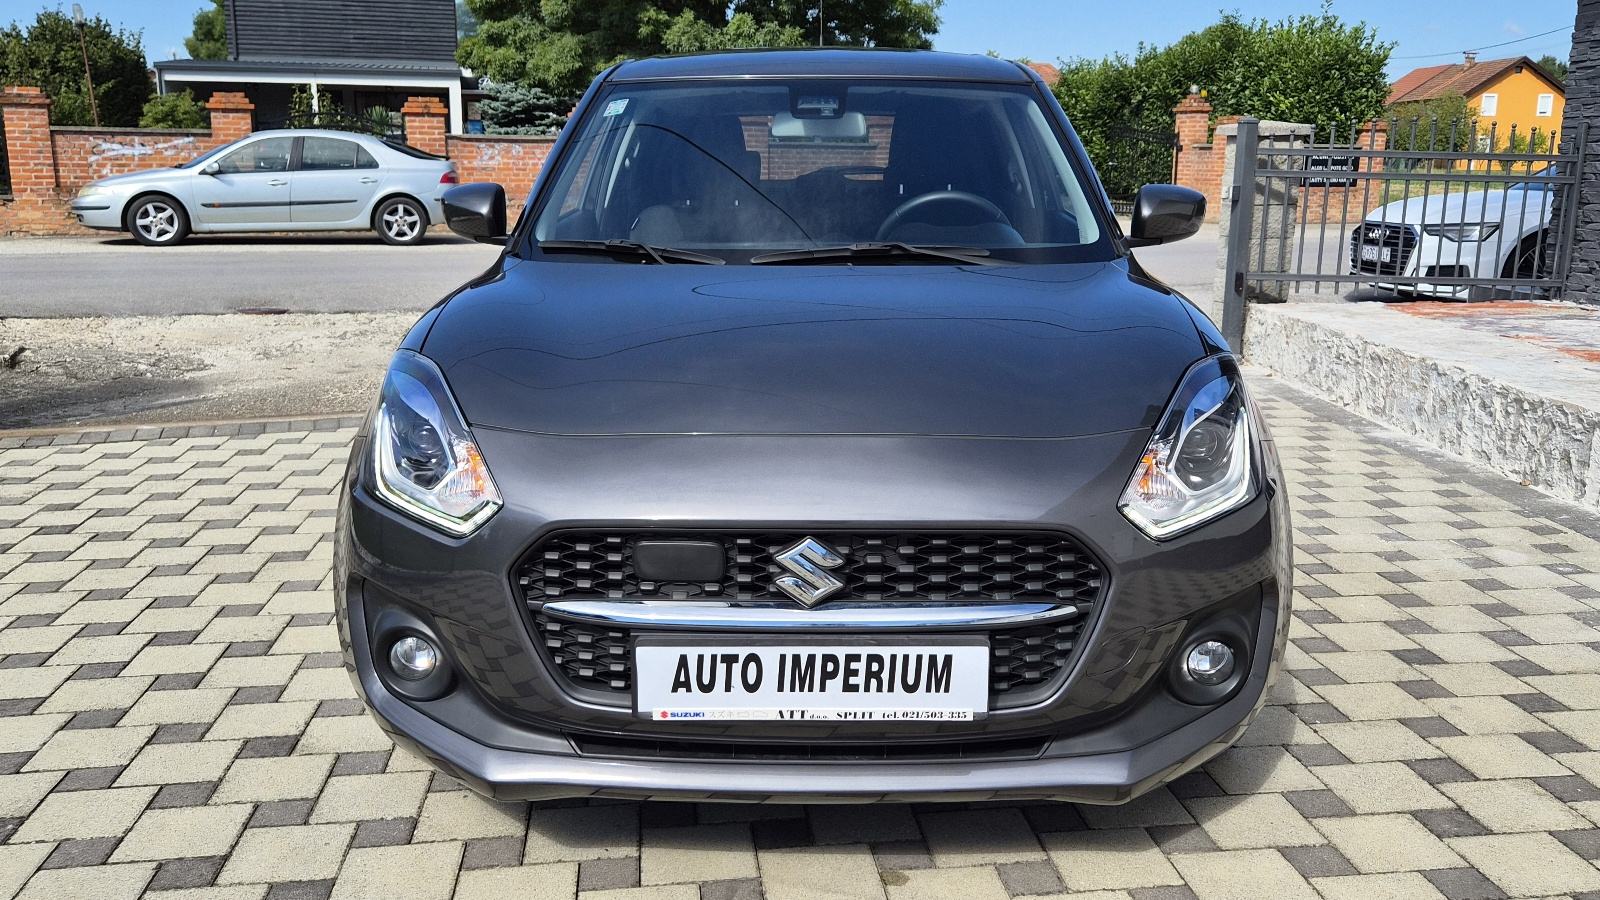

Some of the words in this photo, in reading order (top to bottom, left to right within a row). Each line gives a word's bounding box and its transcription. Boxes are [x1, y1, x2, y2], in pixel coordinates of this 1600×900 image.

[671, 652, 764, 694] AUTO
[776, 653, 953, 694] IMPERIUM
[775, 709, 809, 719] ATT
[835, 711, 877, 719] SPLIT
[882, 711, 899, 719] tel.
[902, 711, 968, 719] 021/503-335
